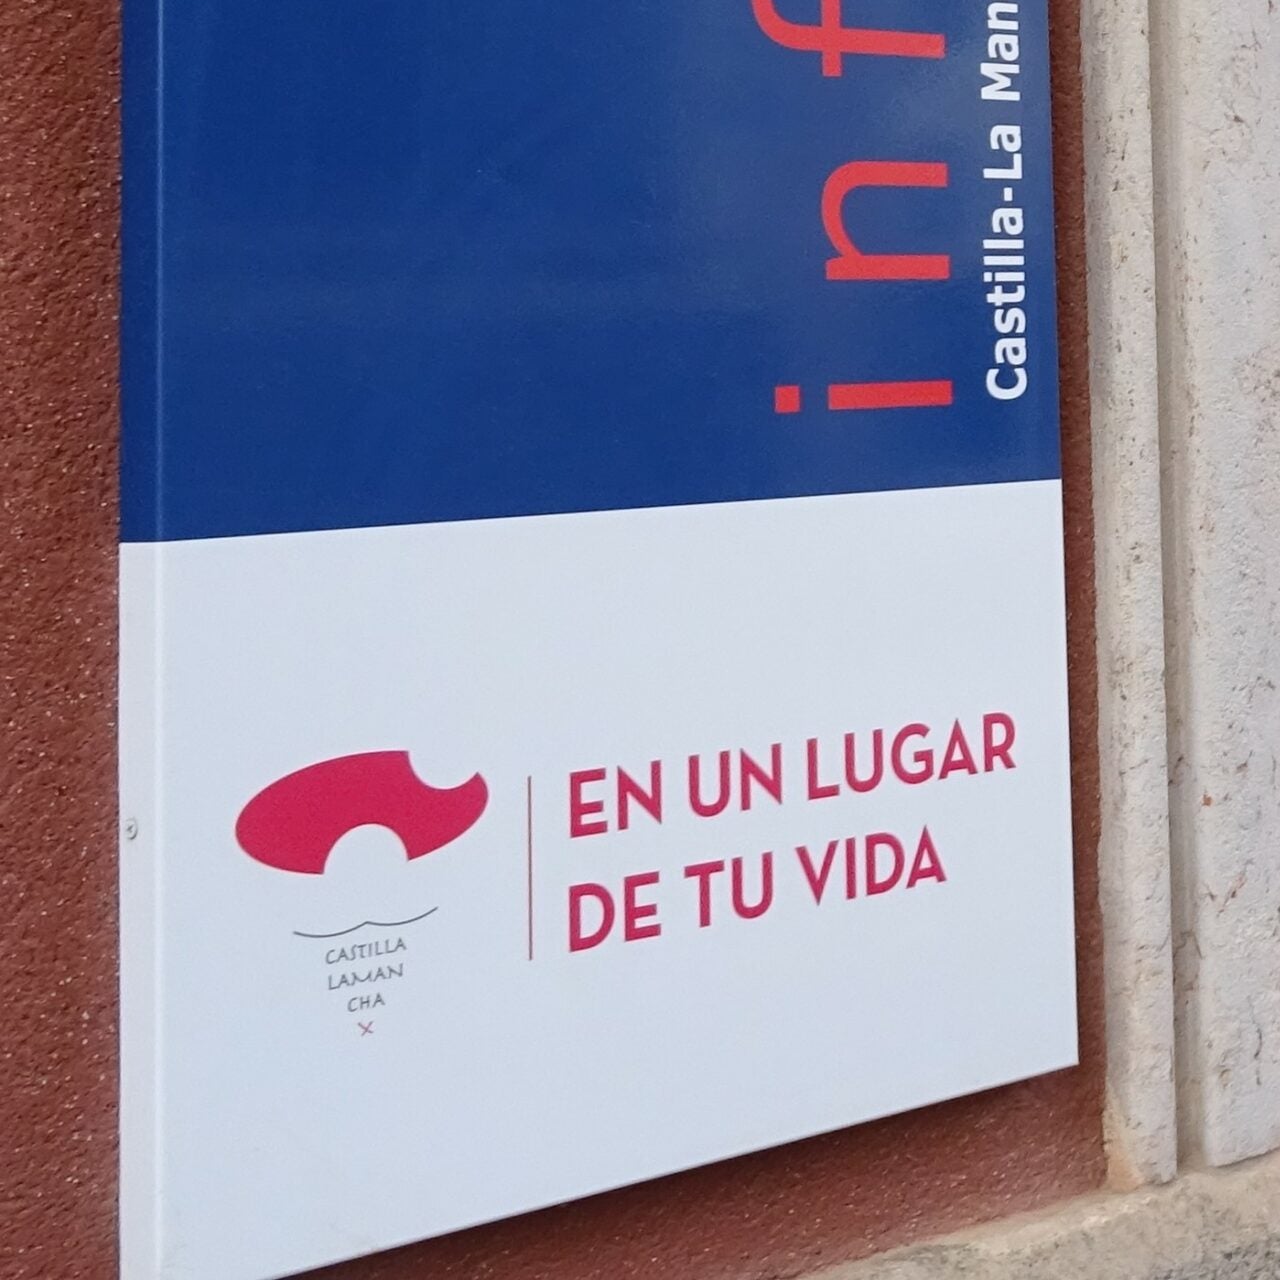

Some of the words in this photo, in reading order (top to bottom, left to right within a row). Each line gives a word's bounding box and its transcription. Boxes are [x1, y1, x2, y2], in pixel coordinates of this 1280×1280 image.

[982, 123, 1028, 401] Castilla-La
[569, 759, 662, 839] EN
[687, 742, 783, 818] UN
[806, 711, 1017, 801] LUGAR
[568, 870, 662, 953] DE
[684, 851, 774, 928] TU
[795, 824, 947, 906] VIDA
[325, 936, 407, 965] CASTILLA
[327, 963, 404, 991] LAMAN
[347, 992, 386, 1013] CHA
